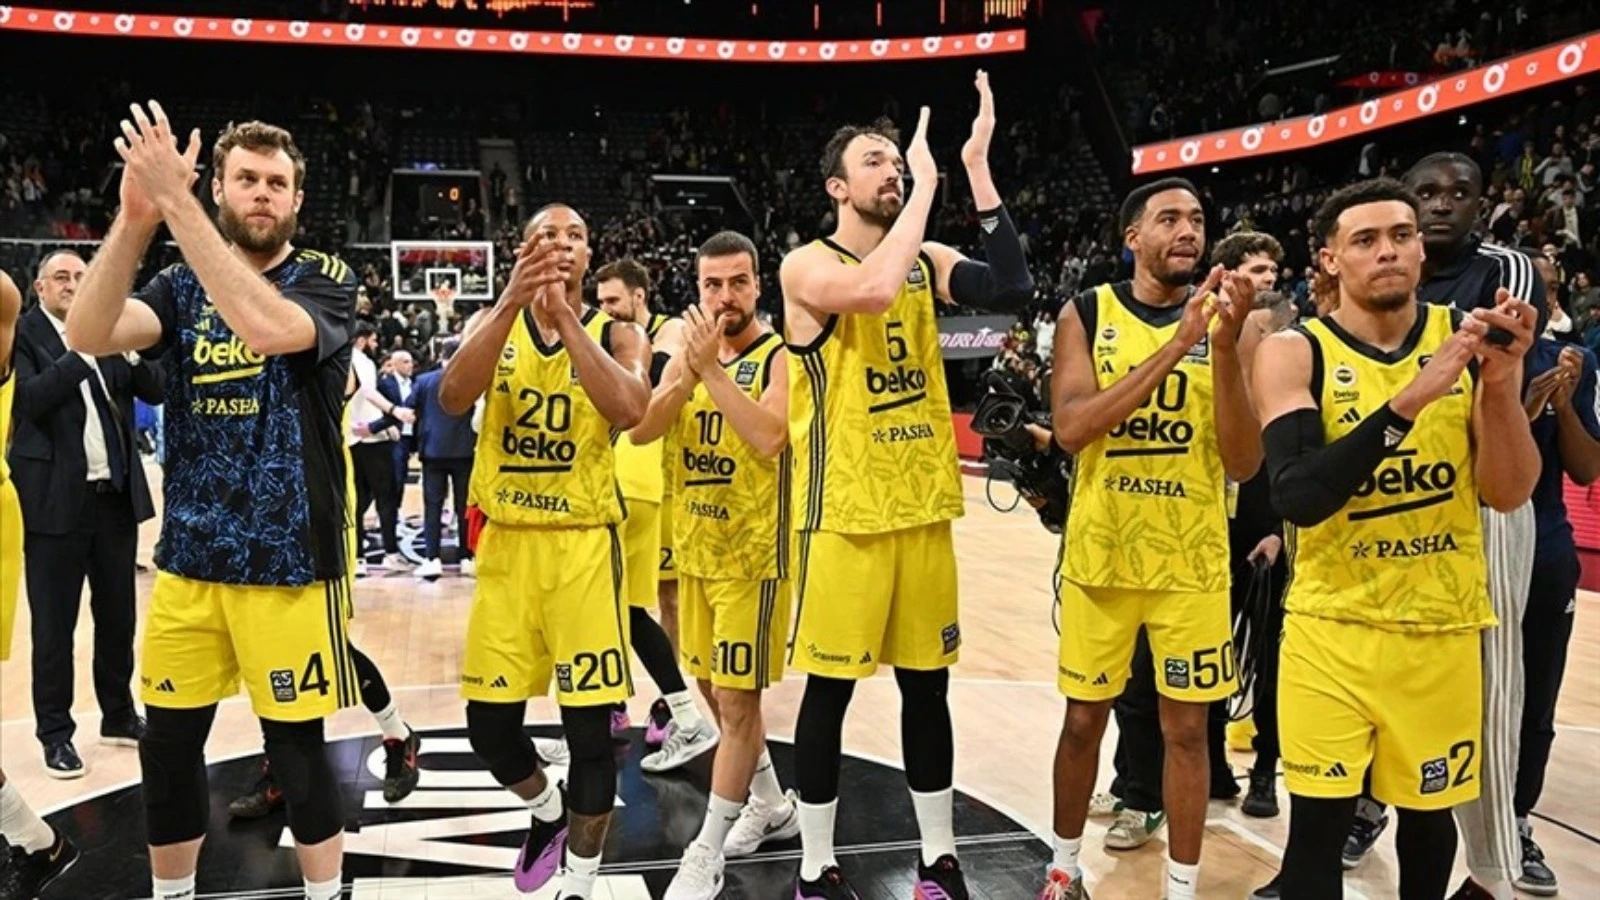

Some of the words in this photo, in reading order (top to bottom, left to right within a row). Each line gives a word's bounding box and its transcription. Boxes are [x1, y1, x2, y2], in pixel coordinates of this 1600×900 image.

[885, 320, 908, 362] 5
[866, 366, 926, 395] beko
[1128, 366, 1188, 412] 0
[205, 398, 260, 415] PASHA
[516, 388, 571, 433] 20
[502, 426, 576, 462] beko
[695, 410, 723, 446] 10
[888, 424, 934, 442] PASHA
[683, 447, 736, 476] beko
[512, 490, 570, 512] PASHA
[1118, 476, 1187, 497] PASHA
[690, 501, 730, 521] PASHA
[1376, 533, 1459, 558] PASHA
[299, 652, 330, 696] 4
[573, 648, 623, 691] 20
[718, 640, 753, 677] 10
[1193, 640, 1234, 689] 50
[1449, 740, 1476, 788] 2
